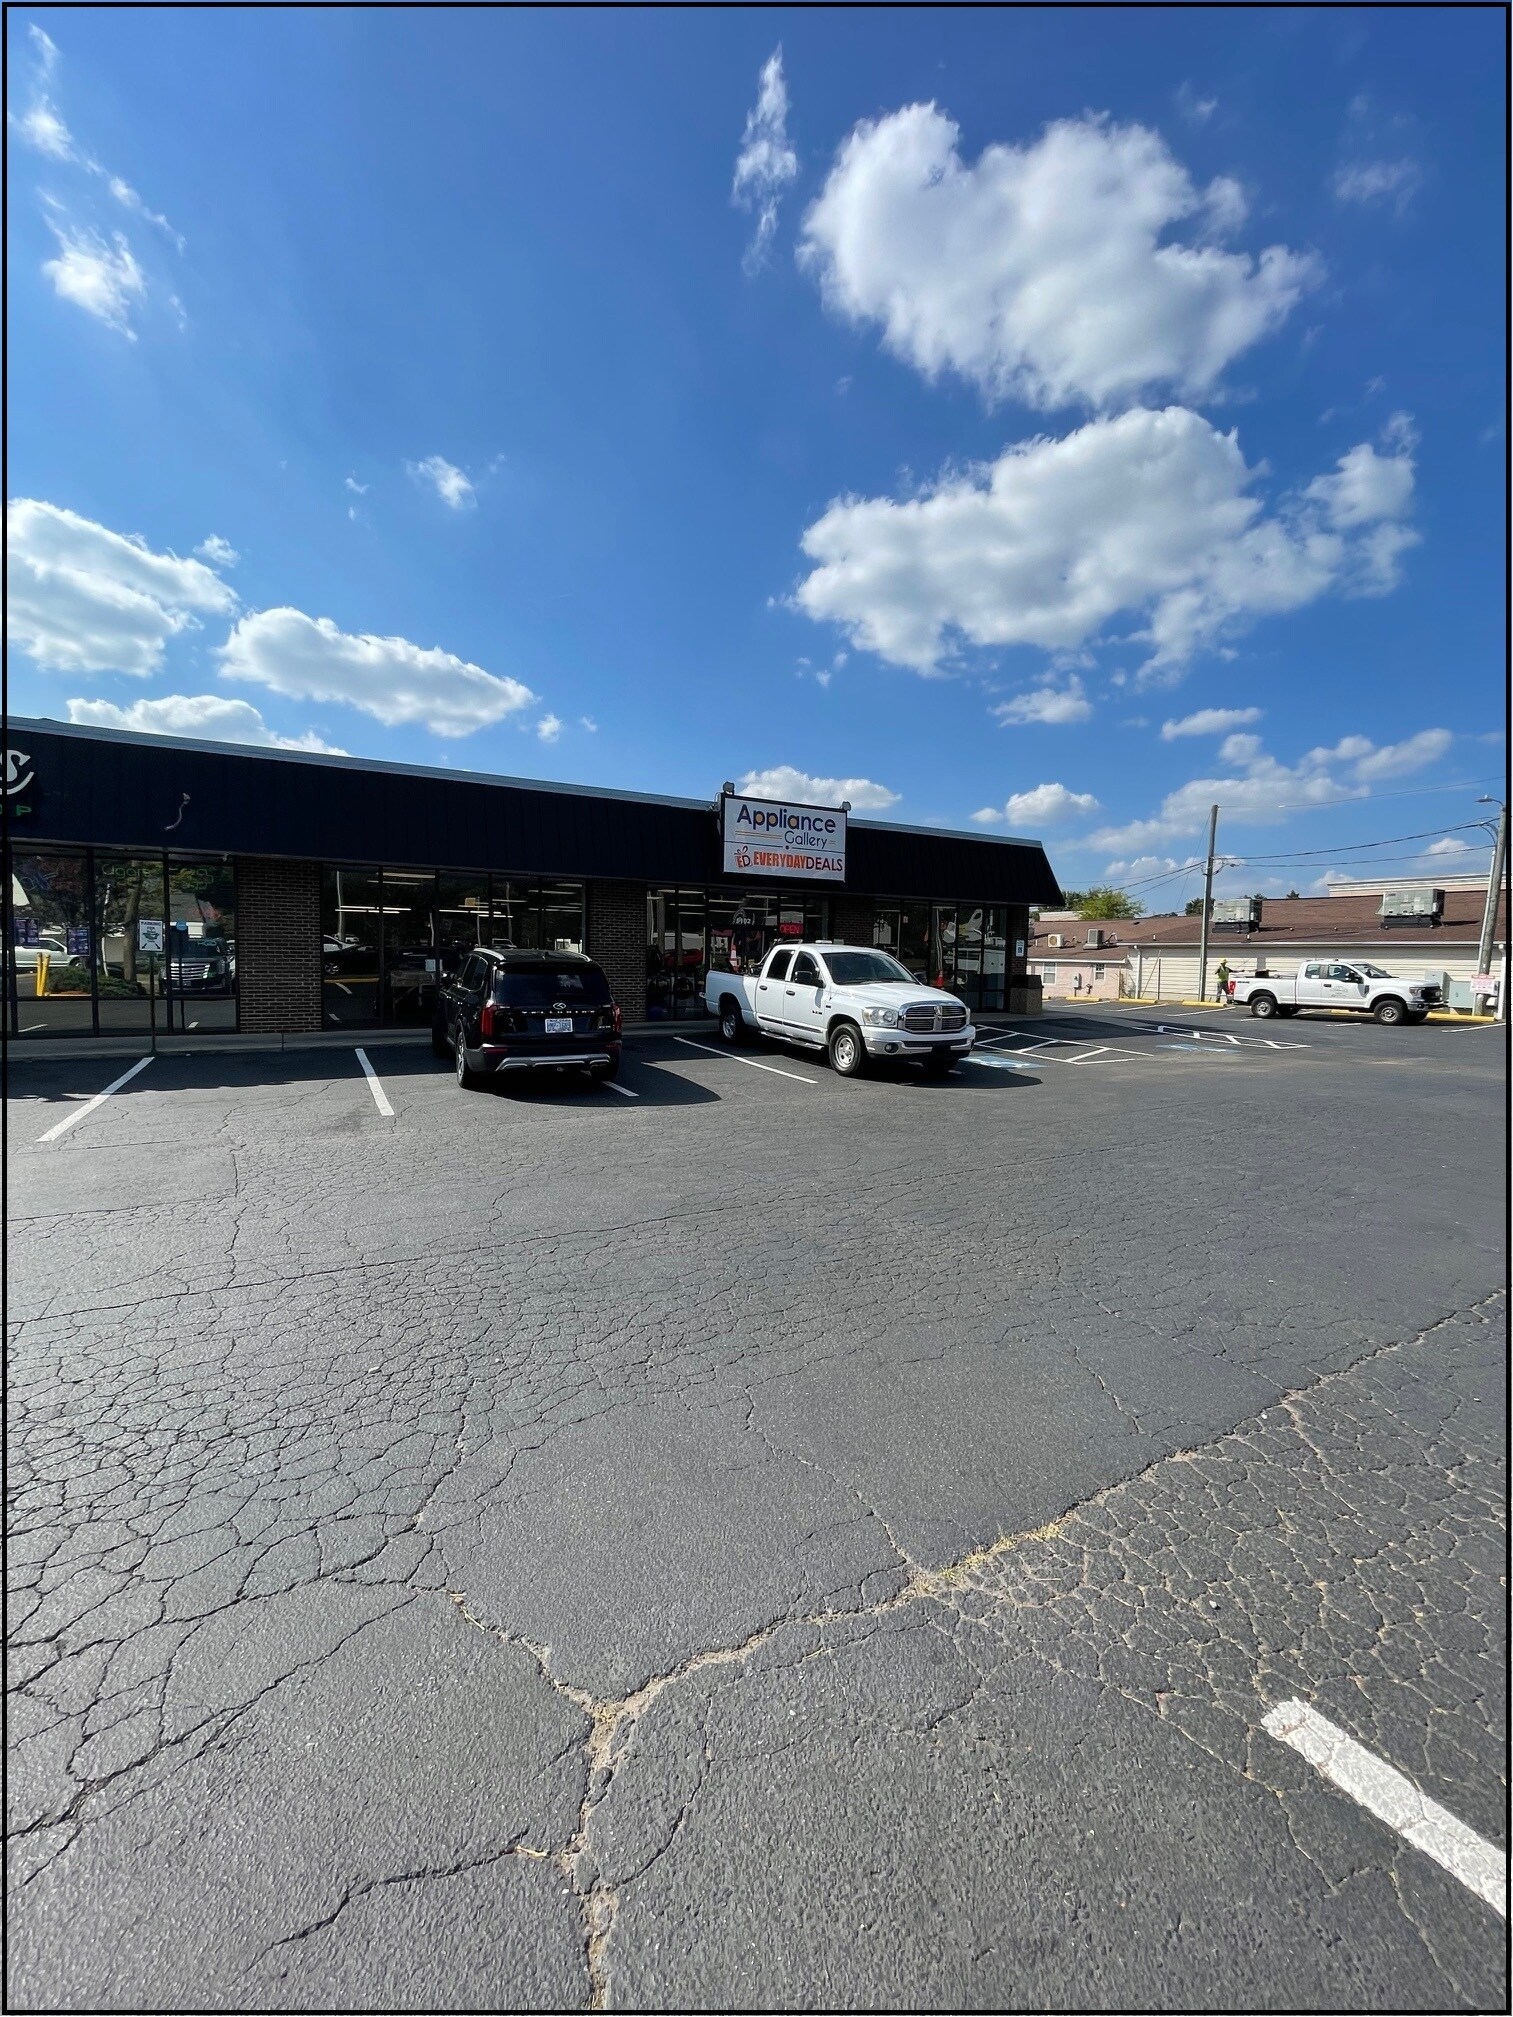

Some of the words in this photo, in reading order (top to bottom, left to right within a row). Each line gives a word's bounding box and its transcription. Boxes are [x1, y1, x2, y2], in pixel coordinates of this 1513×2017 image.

[736, 804, 836, 833] Appliance
[784, 830, 828, 849] Gallery
[780, 924, 800, 934] OPEN
